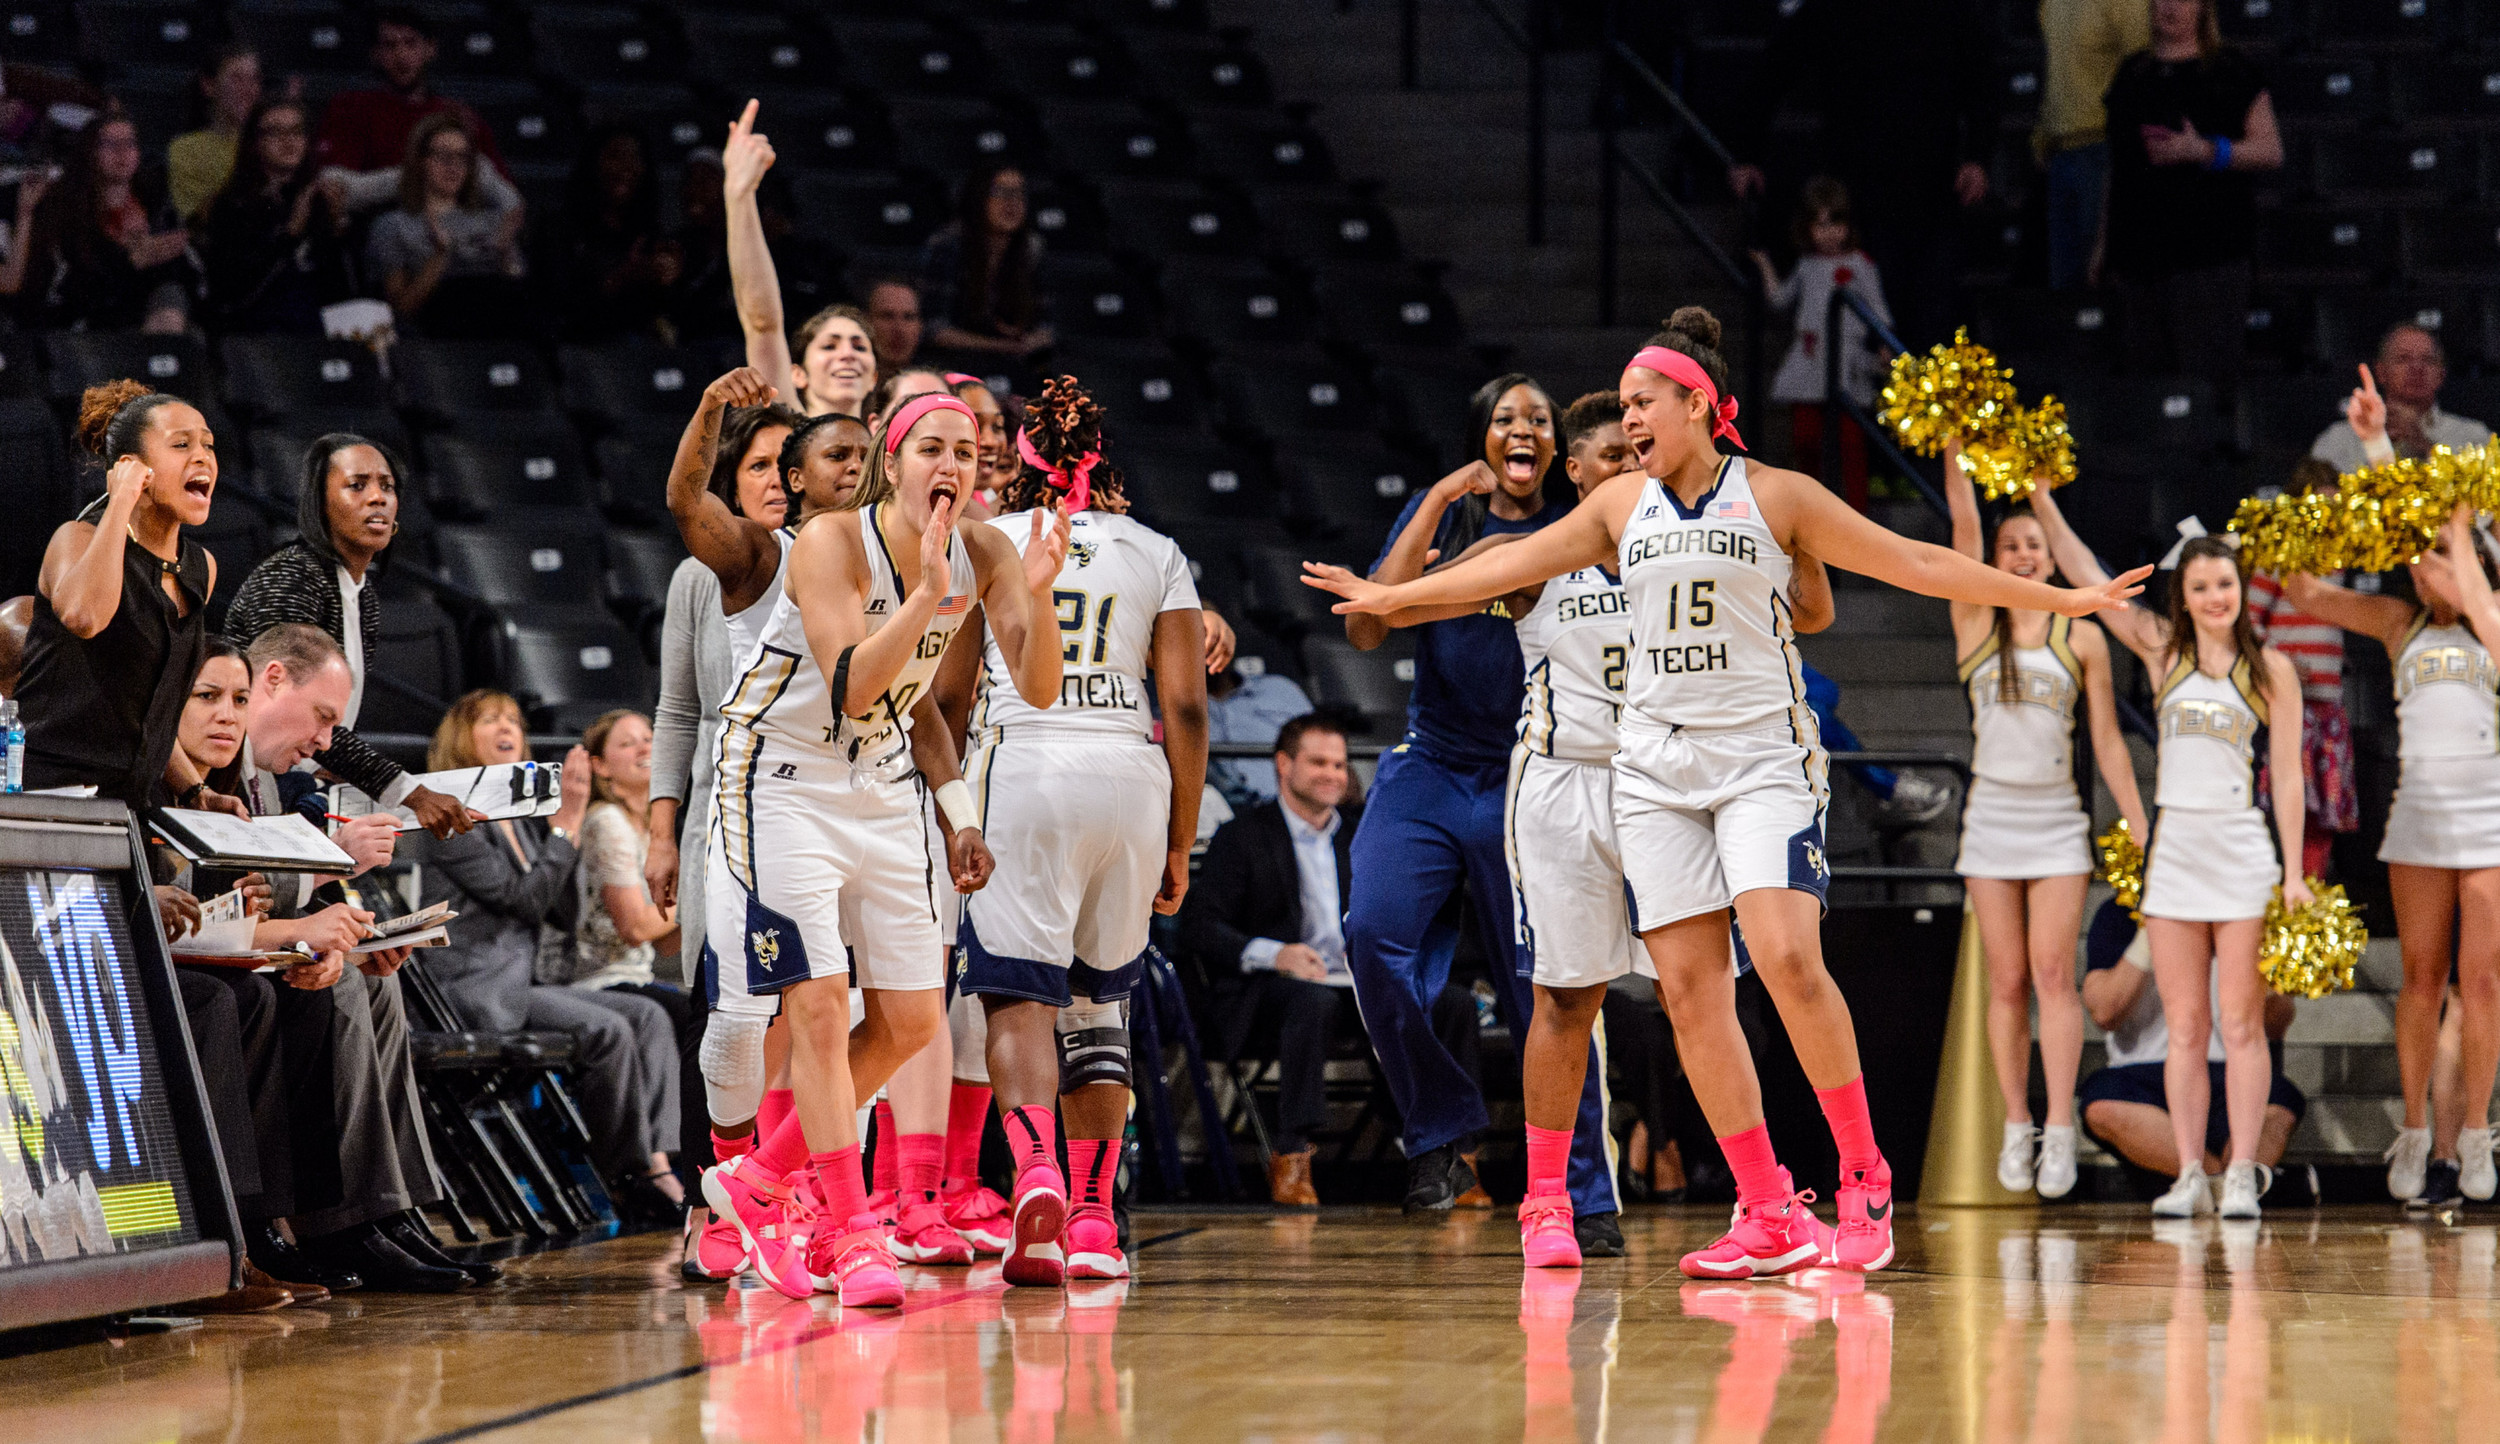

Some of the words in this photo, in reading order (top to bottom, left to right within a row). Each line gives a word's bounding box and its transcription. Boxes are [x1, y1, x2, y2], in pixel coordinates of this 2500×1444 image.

[1628, 529, 1757, 567] GEORGIA
[1052, 587, 1118, 666] 21
[1667, 578, 1717, 633] 15
[1648, 643, 1728, 675] TECH
[2398, 646, 2496, 697] TECH
[2160, 699, 2258, 757] TECH
